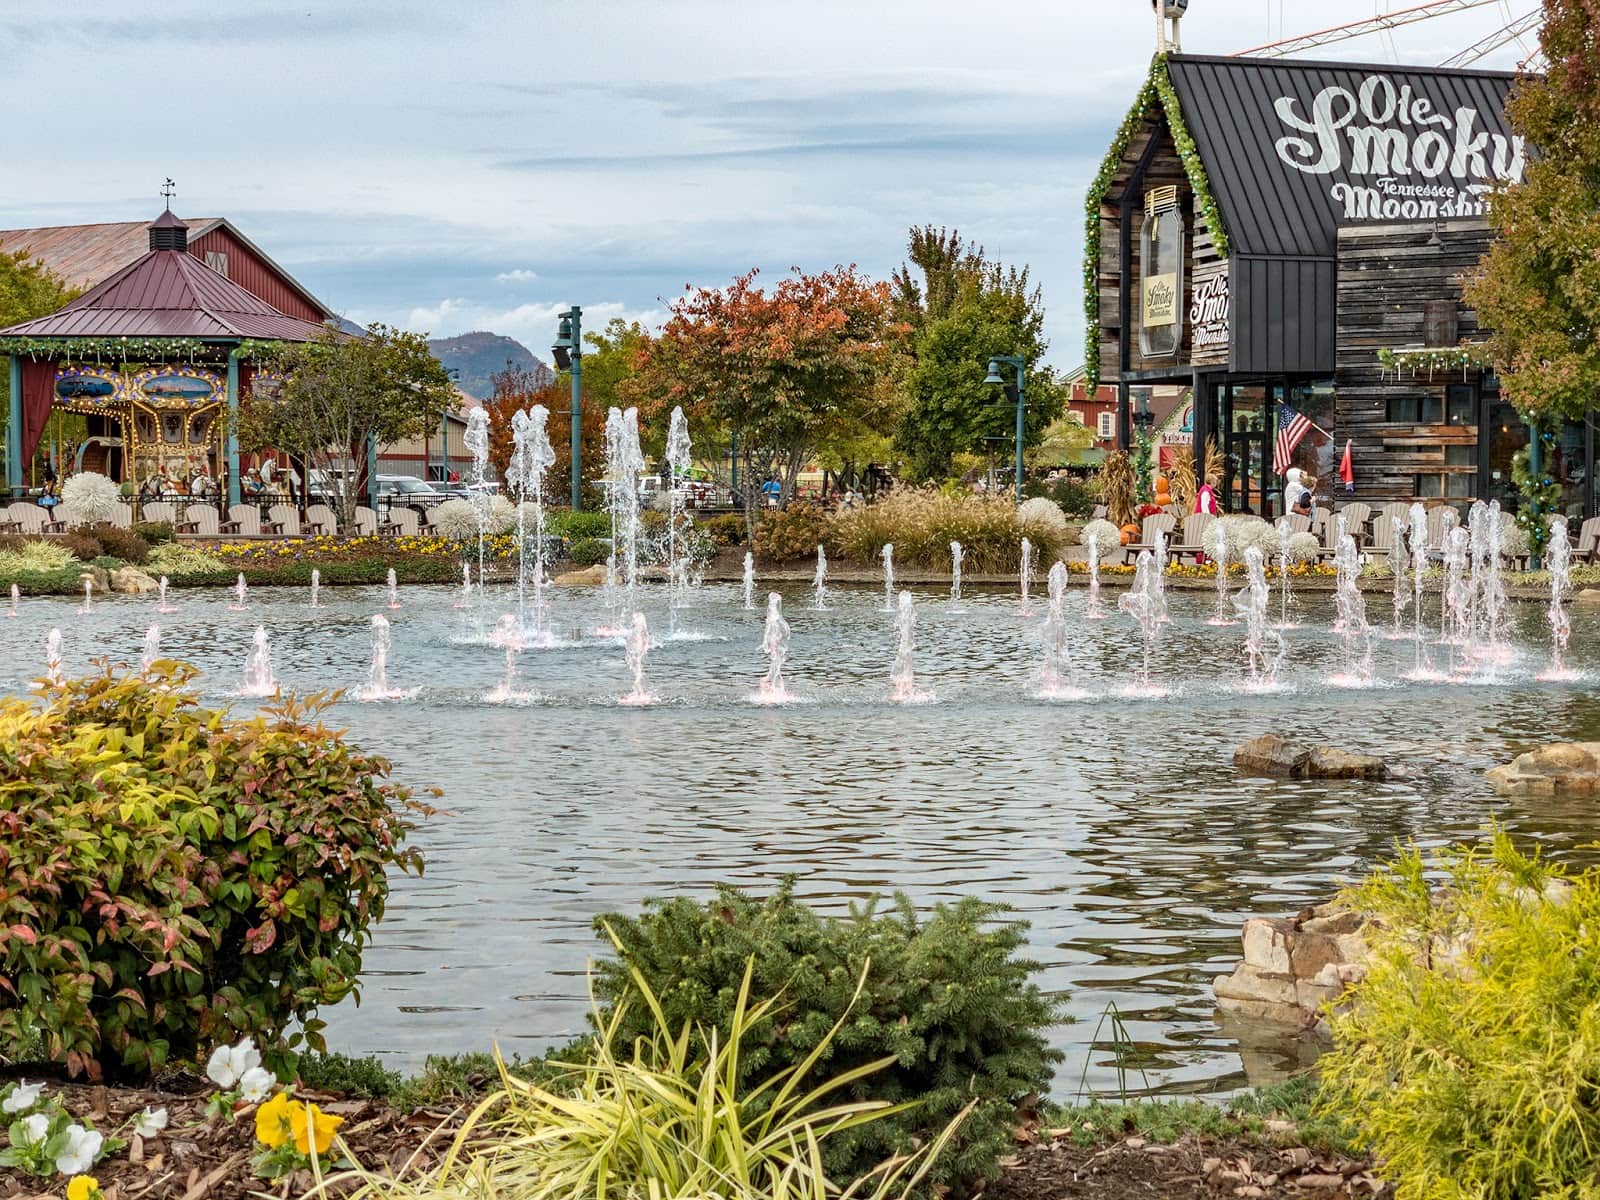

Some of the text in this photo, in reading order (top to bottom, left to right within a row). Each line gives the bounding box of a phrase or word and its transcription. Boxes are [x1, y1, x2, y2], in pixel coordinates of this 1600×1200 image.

[1359, 74, 1452, 130] Ole
[1274, 86, 1526, 194] Smoky
[1376, 177, 1455, 198] Tennessee
[1211, 274, 1229, 297] Ole
